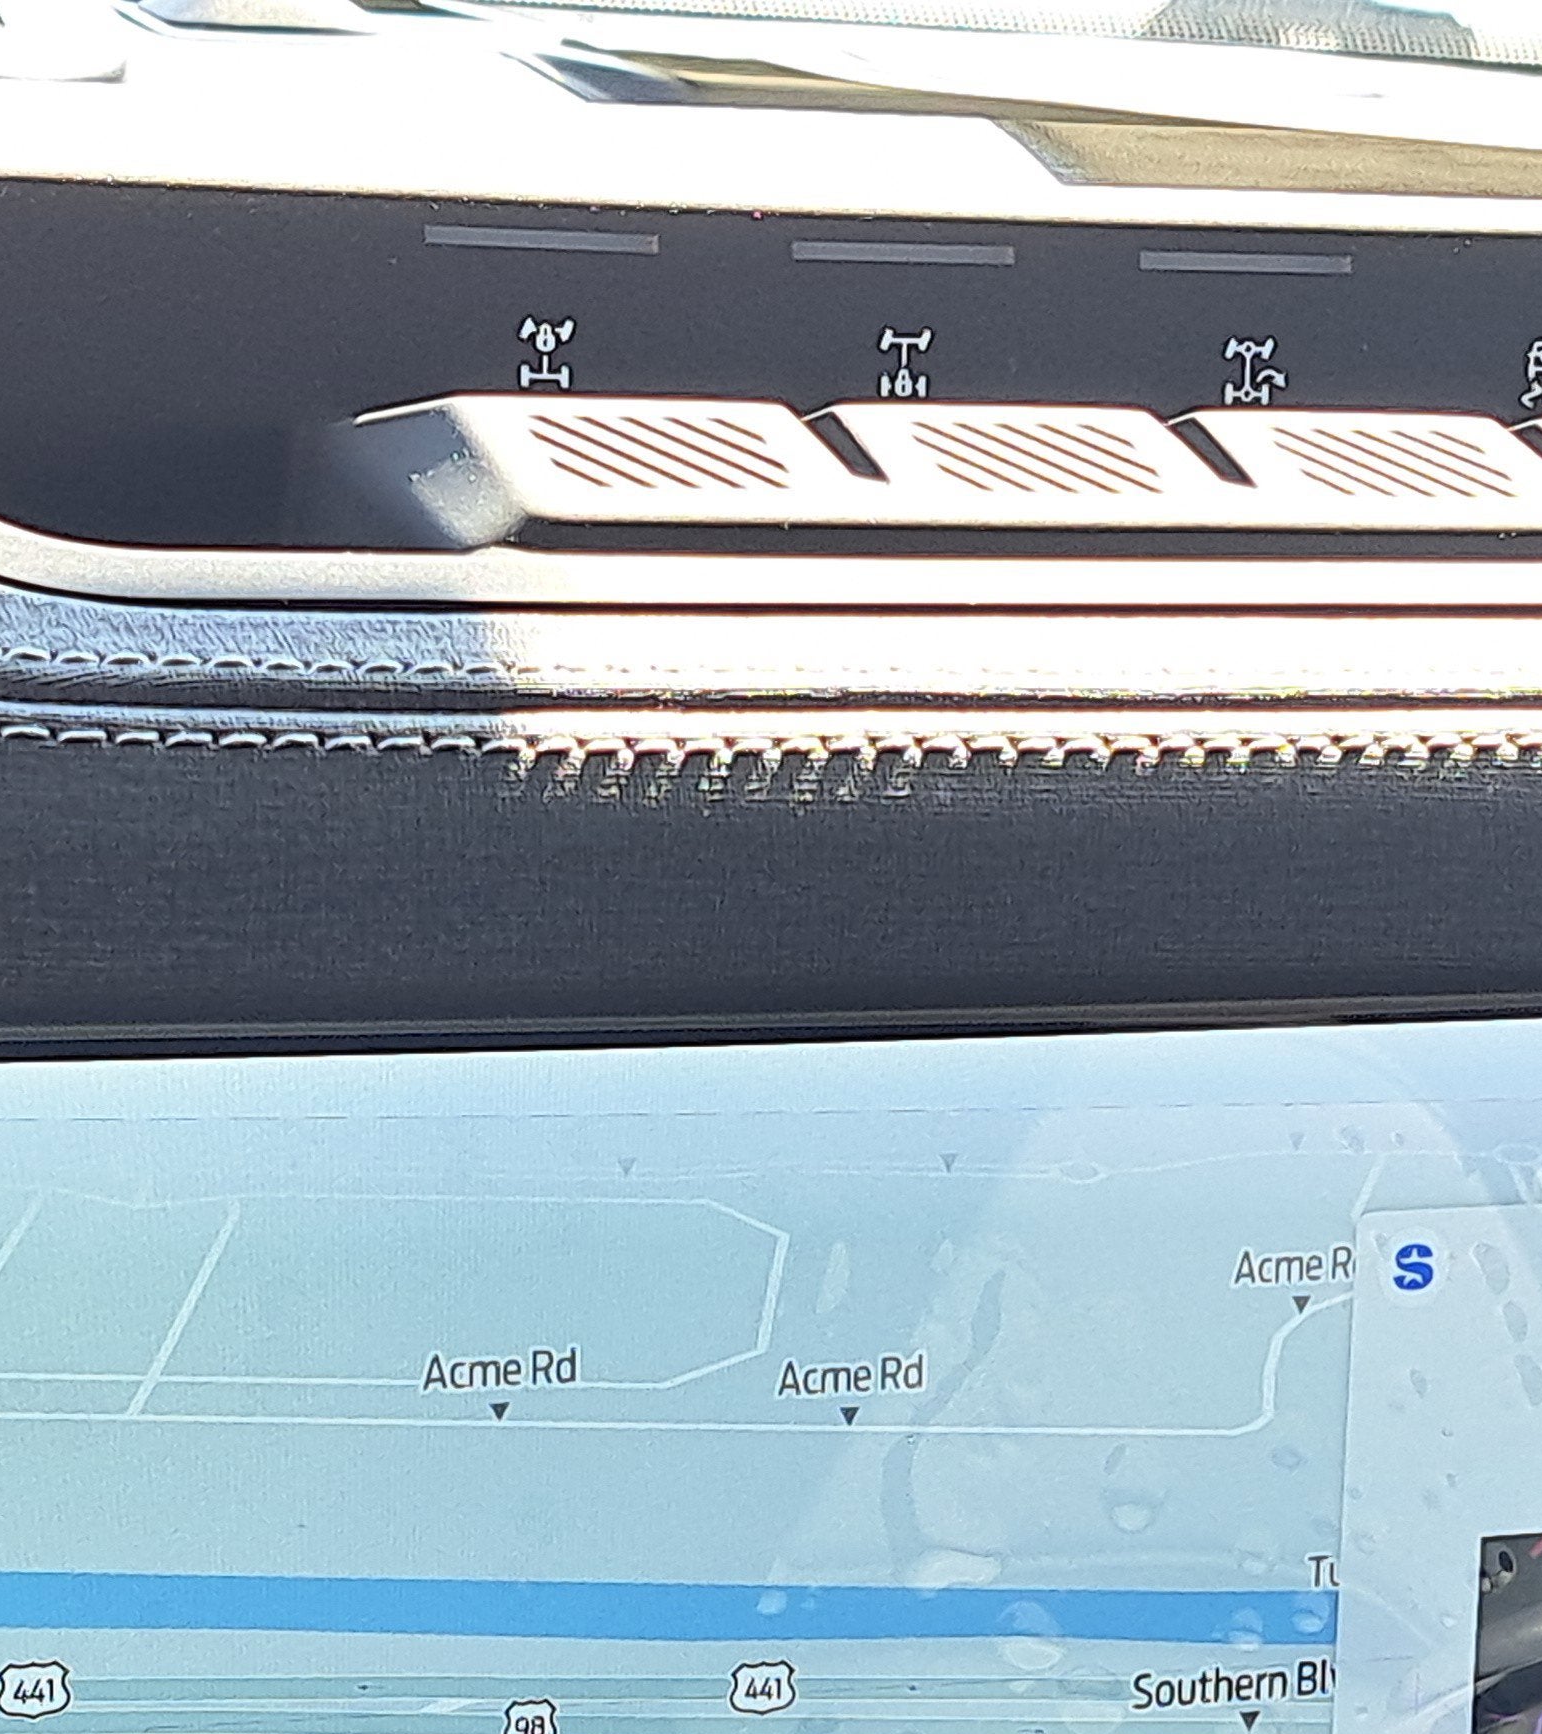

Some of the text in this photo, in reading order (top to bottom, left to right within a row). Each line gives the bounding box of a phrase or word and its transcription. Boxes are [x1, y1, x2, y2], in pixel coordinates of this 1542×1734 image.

[1234, 1249, 1322, 1284] Acme
[422, 1347, 577, 1391] Acme Rd
[777, 1354, 924, 1397] Acme Rd
[13, 1678, 55, 1704] 441
[743, 1676, 784, 1703] 441
[1131, 1666, 1288, 1710] Southern
